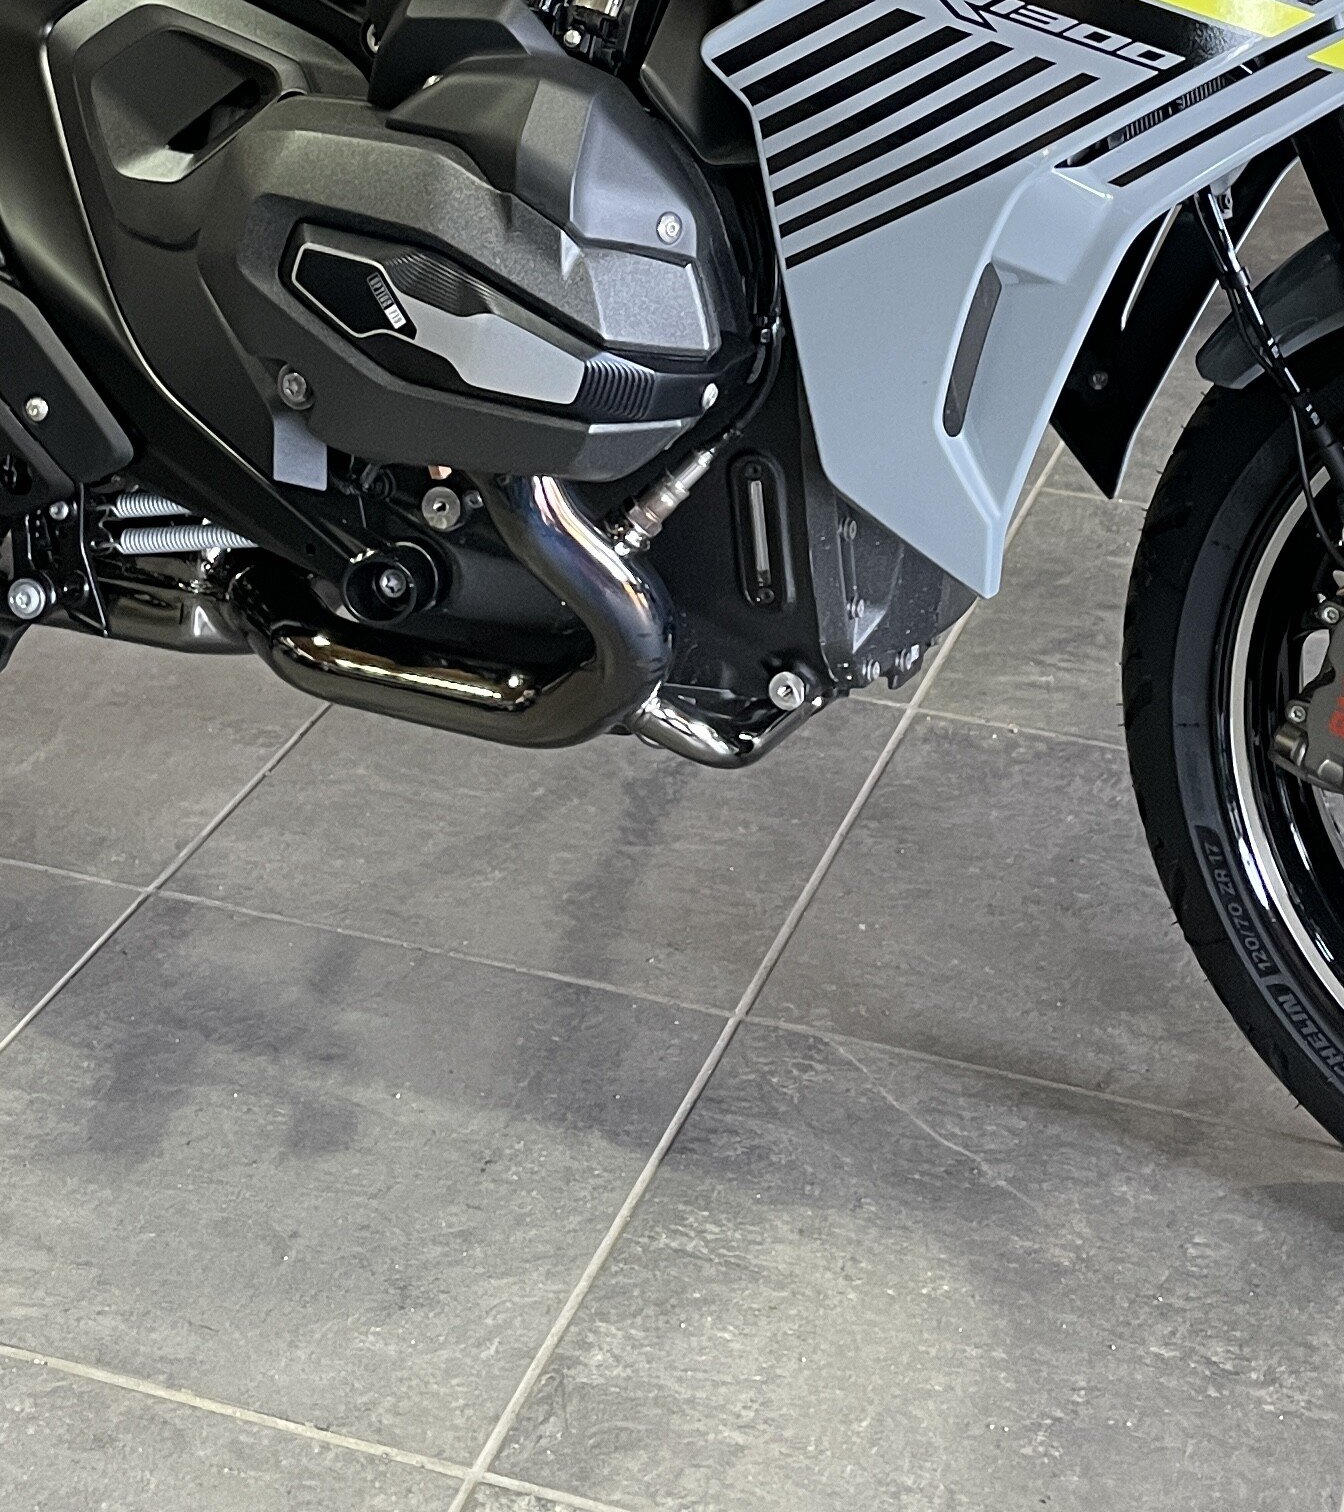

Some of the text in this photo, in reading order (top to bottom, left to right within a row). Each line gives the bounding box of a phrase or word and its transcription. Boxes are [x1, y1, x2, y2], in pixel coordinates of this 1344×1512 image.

[1204, 841, 1223, 865] 17
[1214, 868, 1237, 897] ZR
[1228, 901, 1272, 971] 120/70
